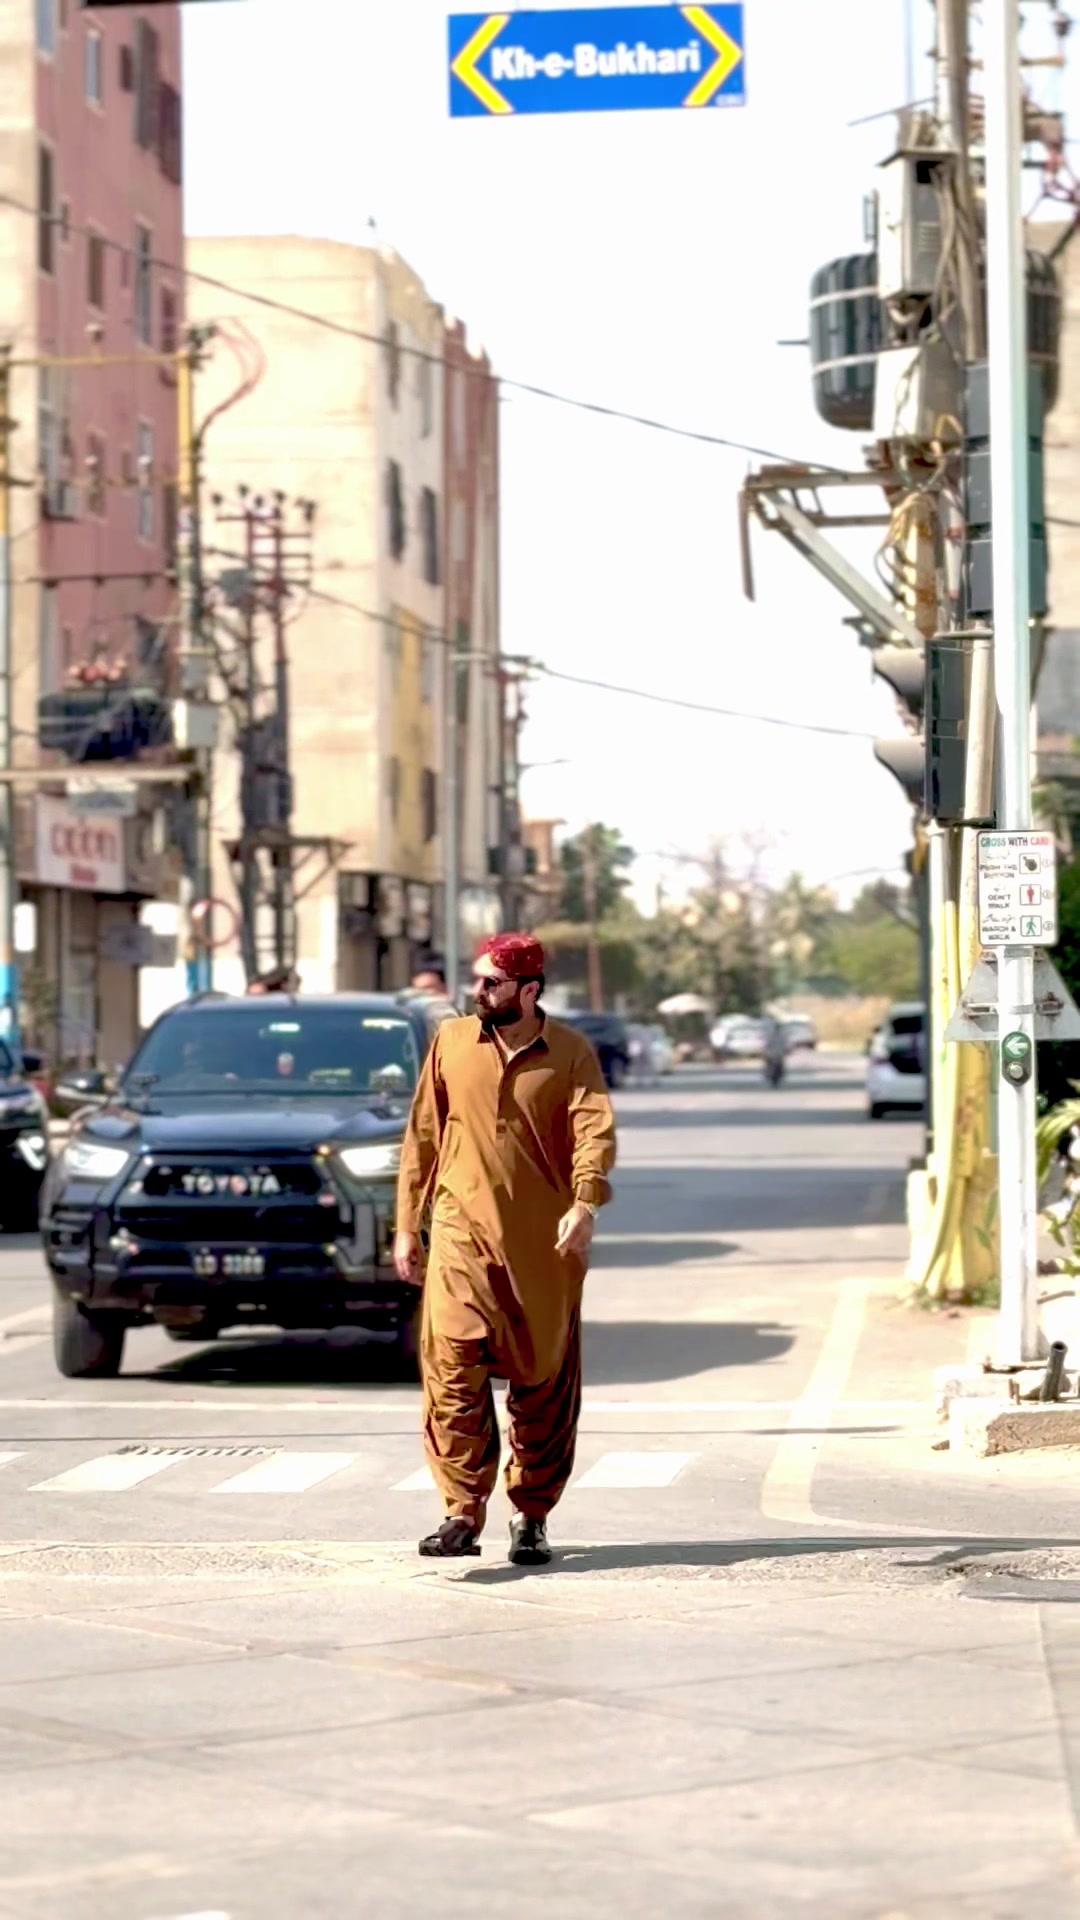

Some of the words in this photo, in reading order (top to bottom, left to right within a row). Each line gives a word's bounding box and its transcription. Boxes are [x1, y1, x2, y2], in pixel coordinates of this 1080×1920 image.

[491, 39, 701, 80] Kh-e-Bukhari
[981, 837, 1006, 847] CROSS
[1008, 837, 1028, 846] WITH
[181, 1175, 281, 1194] TOYOTA
